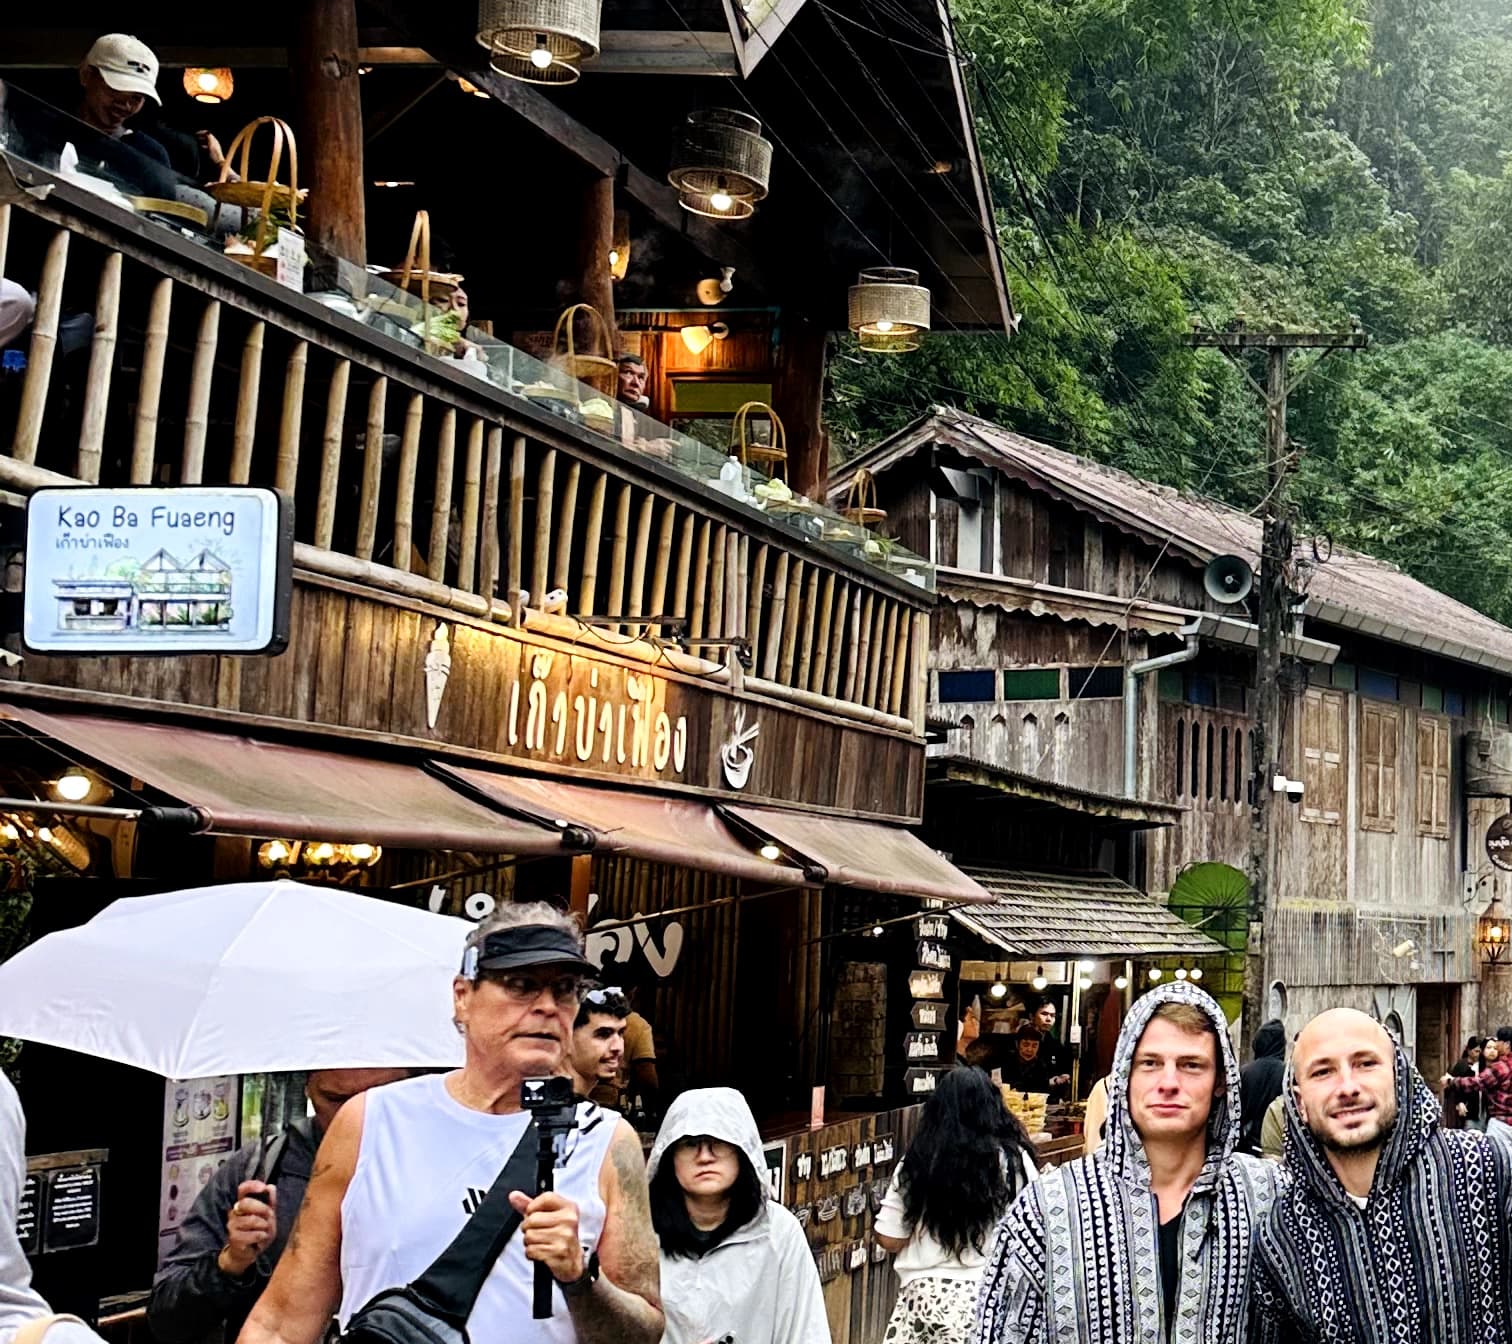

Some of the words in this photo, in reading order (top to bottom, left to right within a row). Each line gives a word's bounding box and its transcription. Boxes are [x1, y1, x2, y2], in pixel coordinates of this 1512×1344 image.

[57, 505, 101, 529] Kao
[112, 505, 139, 529] Ba
[150, 505, 236, 536] Fuaeng
